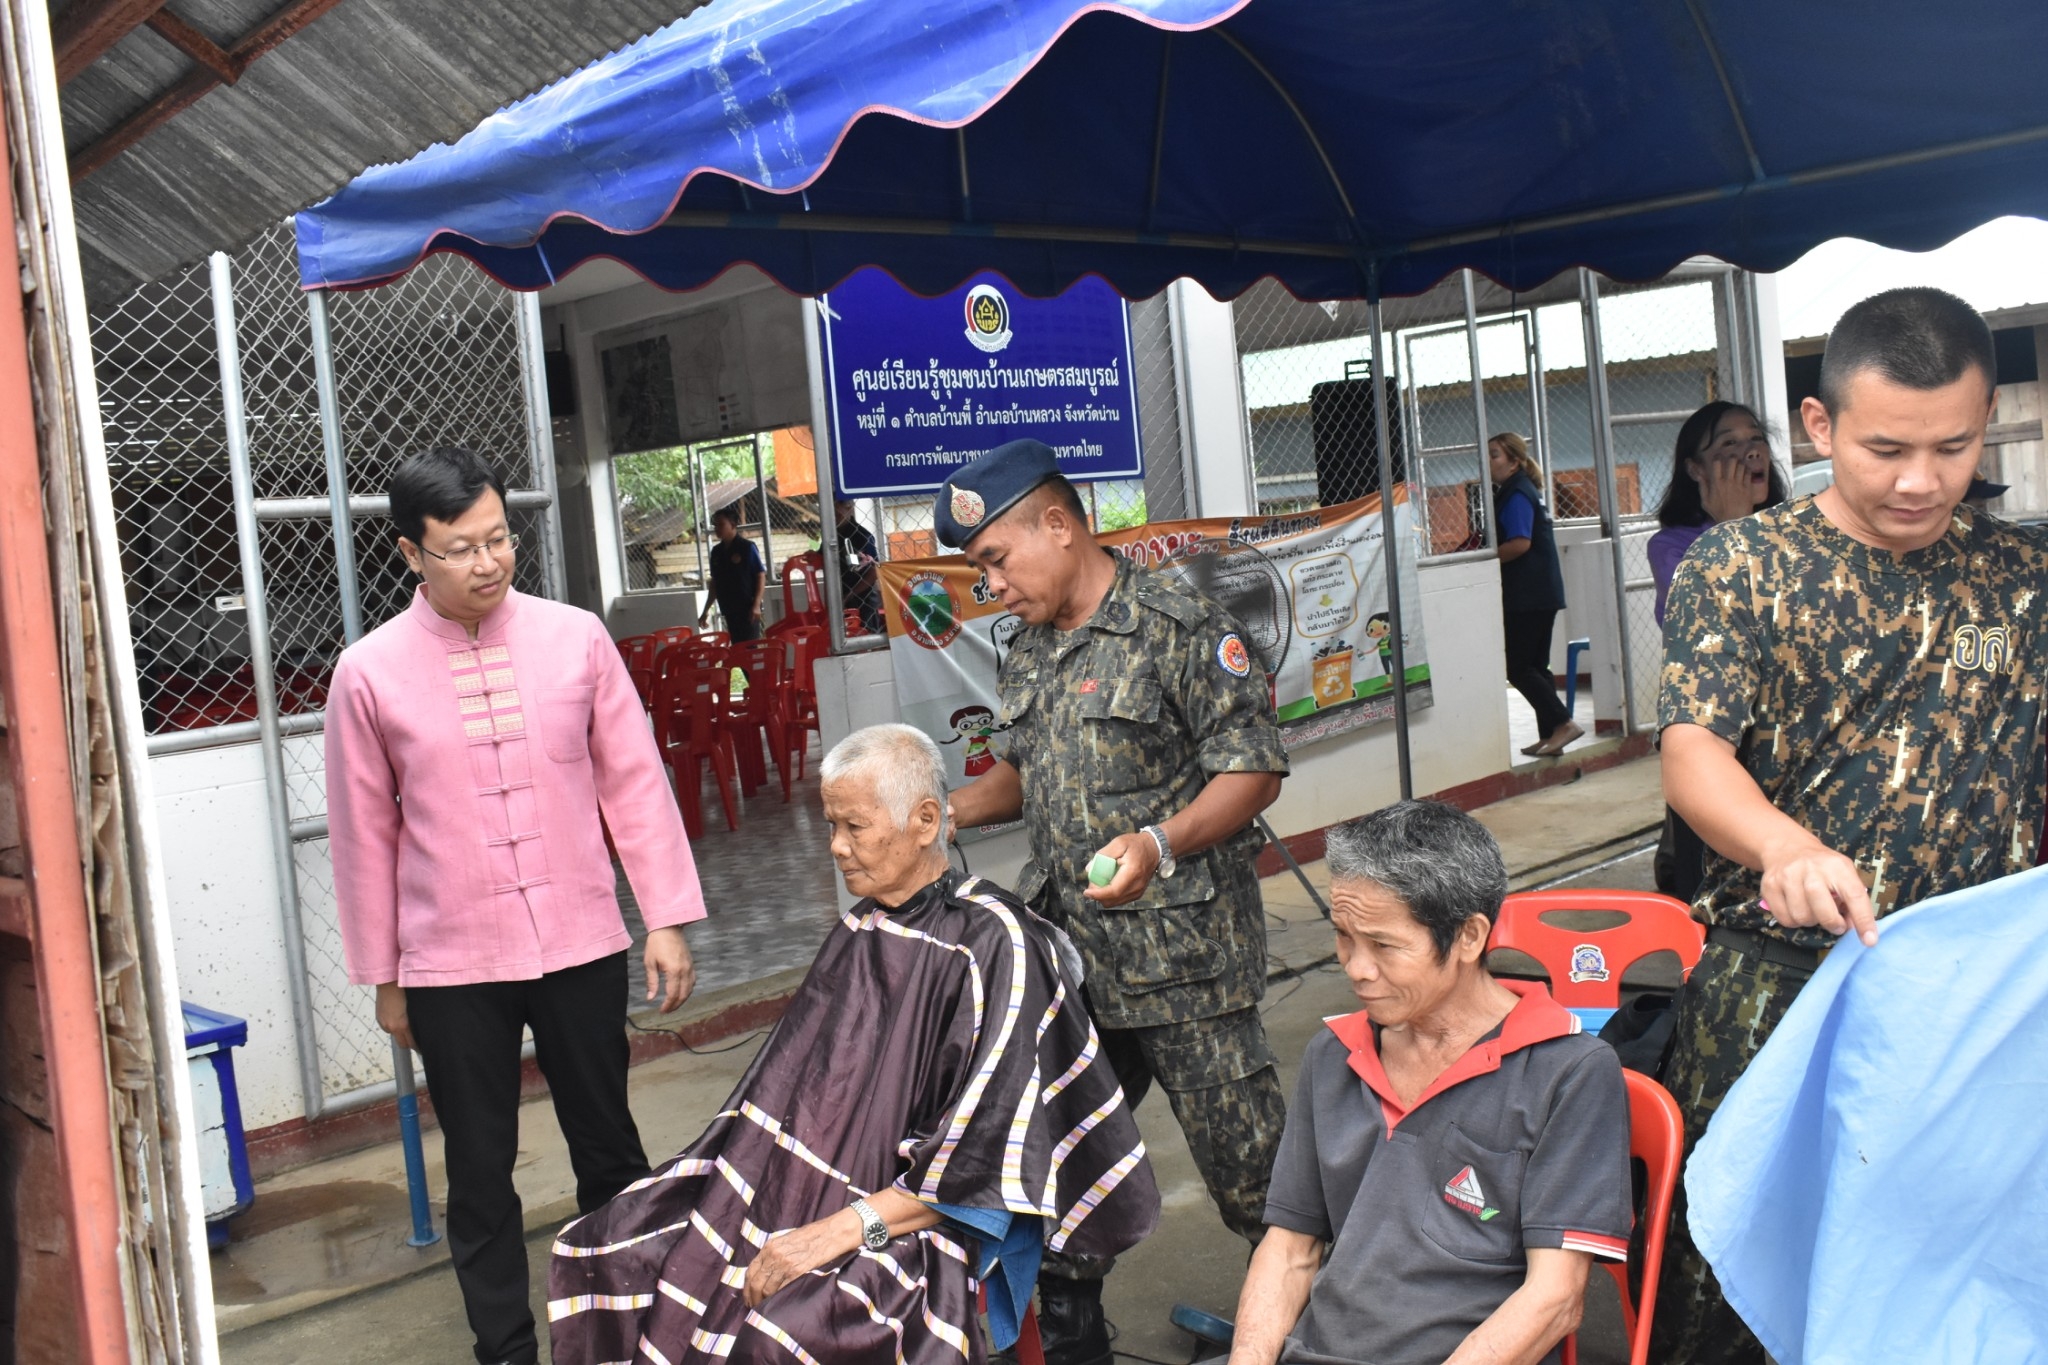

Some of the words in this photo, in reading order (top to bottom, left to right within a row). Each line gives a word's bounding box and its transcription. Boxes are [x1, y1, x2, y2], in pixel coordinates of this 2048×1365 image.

[853, 357, 1120, 402] ศูนย์เรียนรู้ชุมชนบ้านเกษตรสมบูรณ์
[857, 402, 886, 437] หมู่ที่
[891, 417, 901, 429] ๑
[905, 398, 972, 428] ตำบลบ้านพี้
[976, 403, 1061, 425] อำเภอบ้านหลวง
[1064, 403, 1120, 423] จังหวัดน่าน
[1954, 622, 2015, 675] อส.
